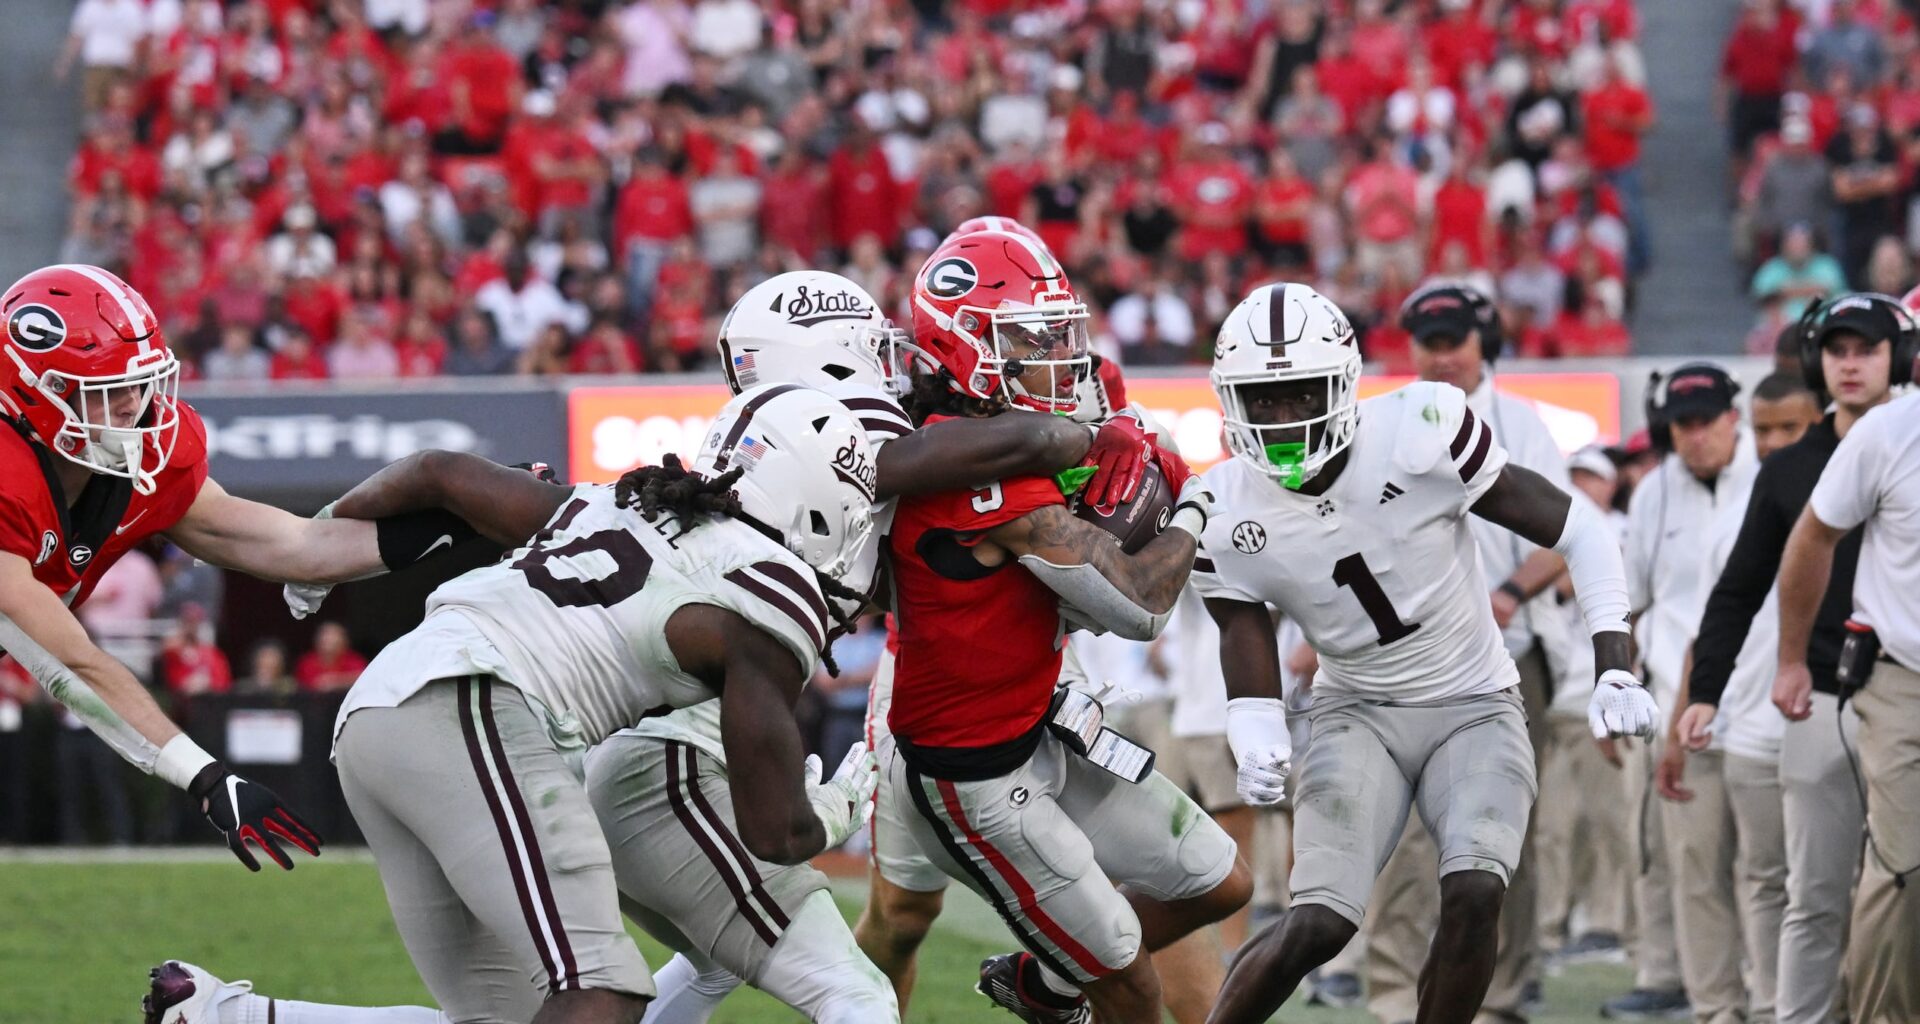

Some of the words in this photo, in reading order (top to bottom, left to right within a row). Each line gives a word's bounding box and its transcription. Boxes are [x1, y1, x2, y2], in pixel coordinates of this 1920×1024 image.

[924, 256, 978, 300] G
[788, 286, 874, 320] State
[8, 303, 67, 353] G
[69, 546, 92, 566] G
[1232, 521, 1267, 554] SEC
[1332, 552, 1421, 647] 1
